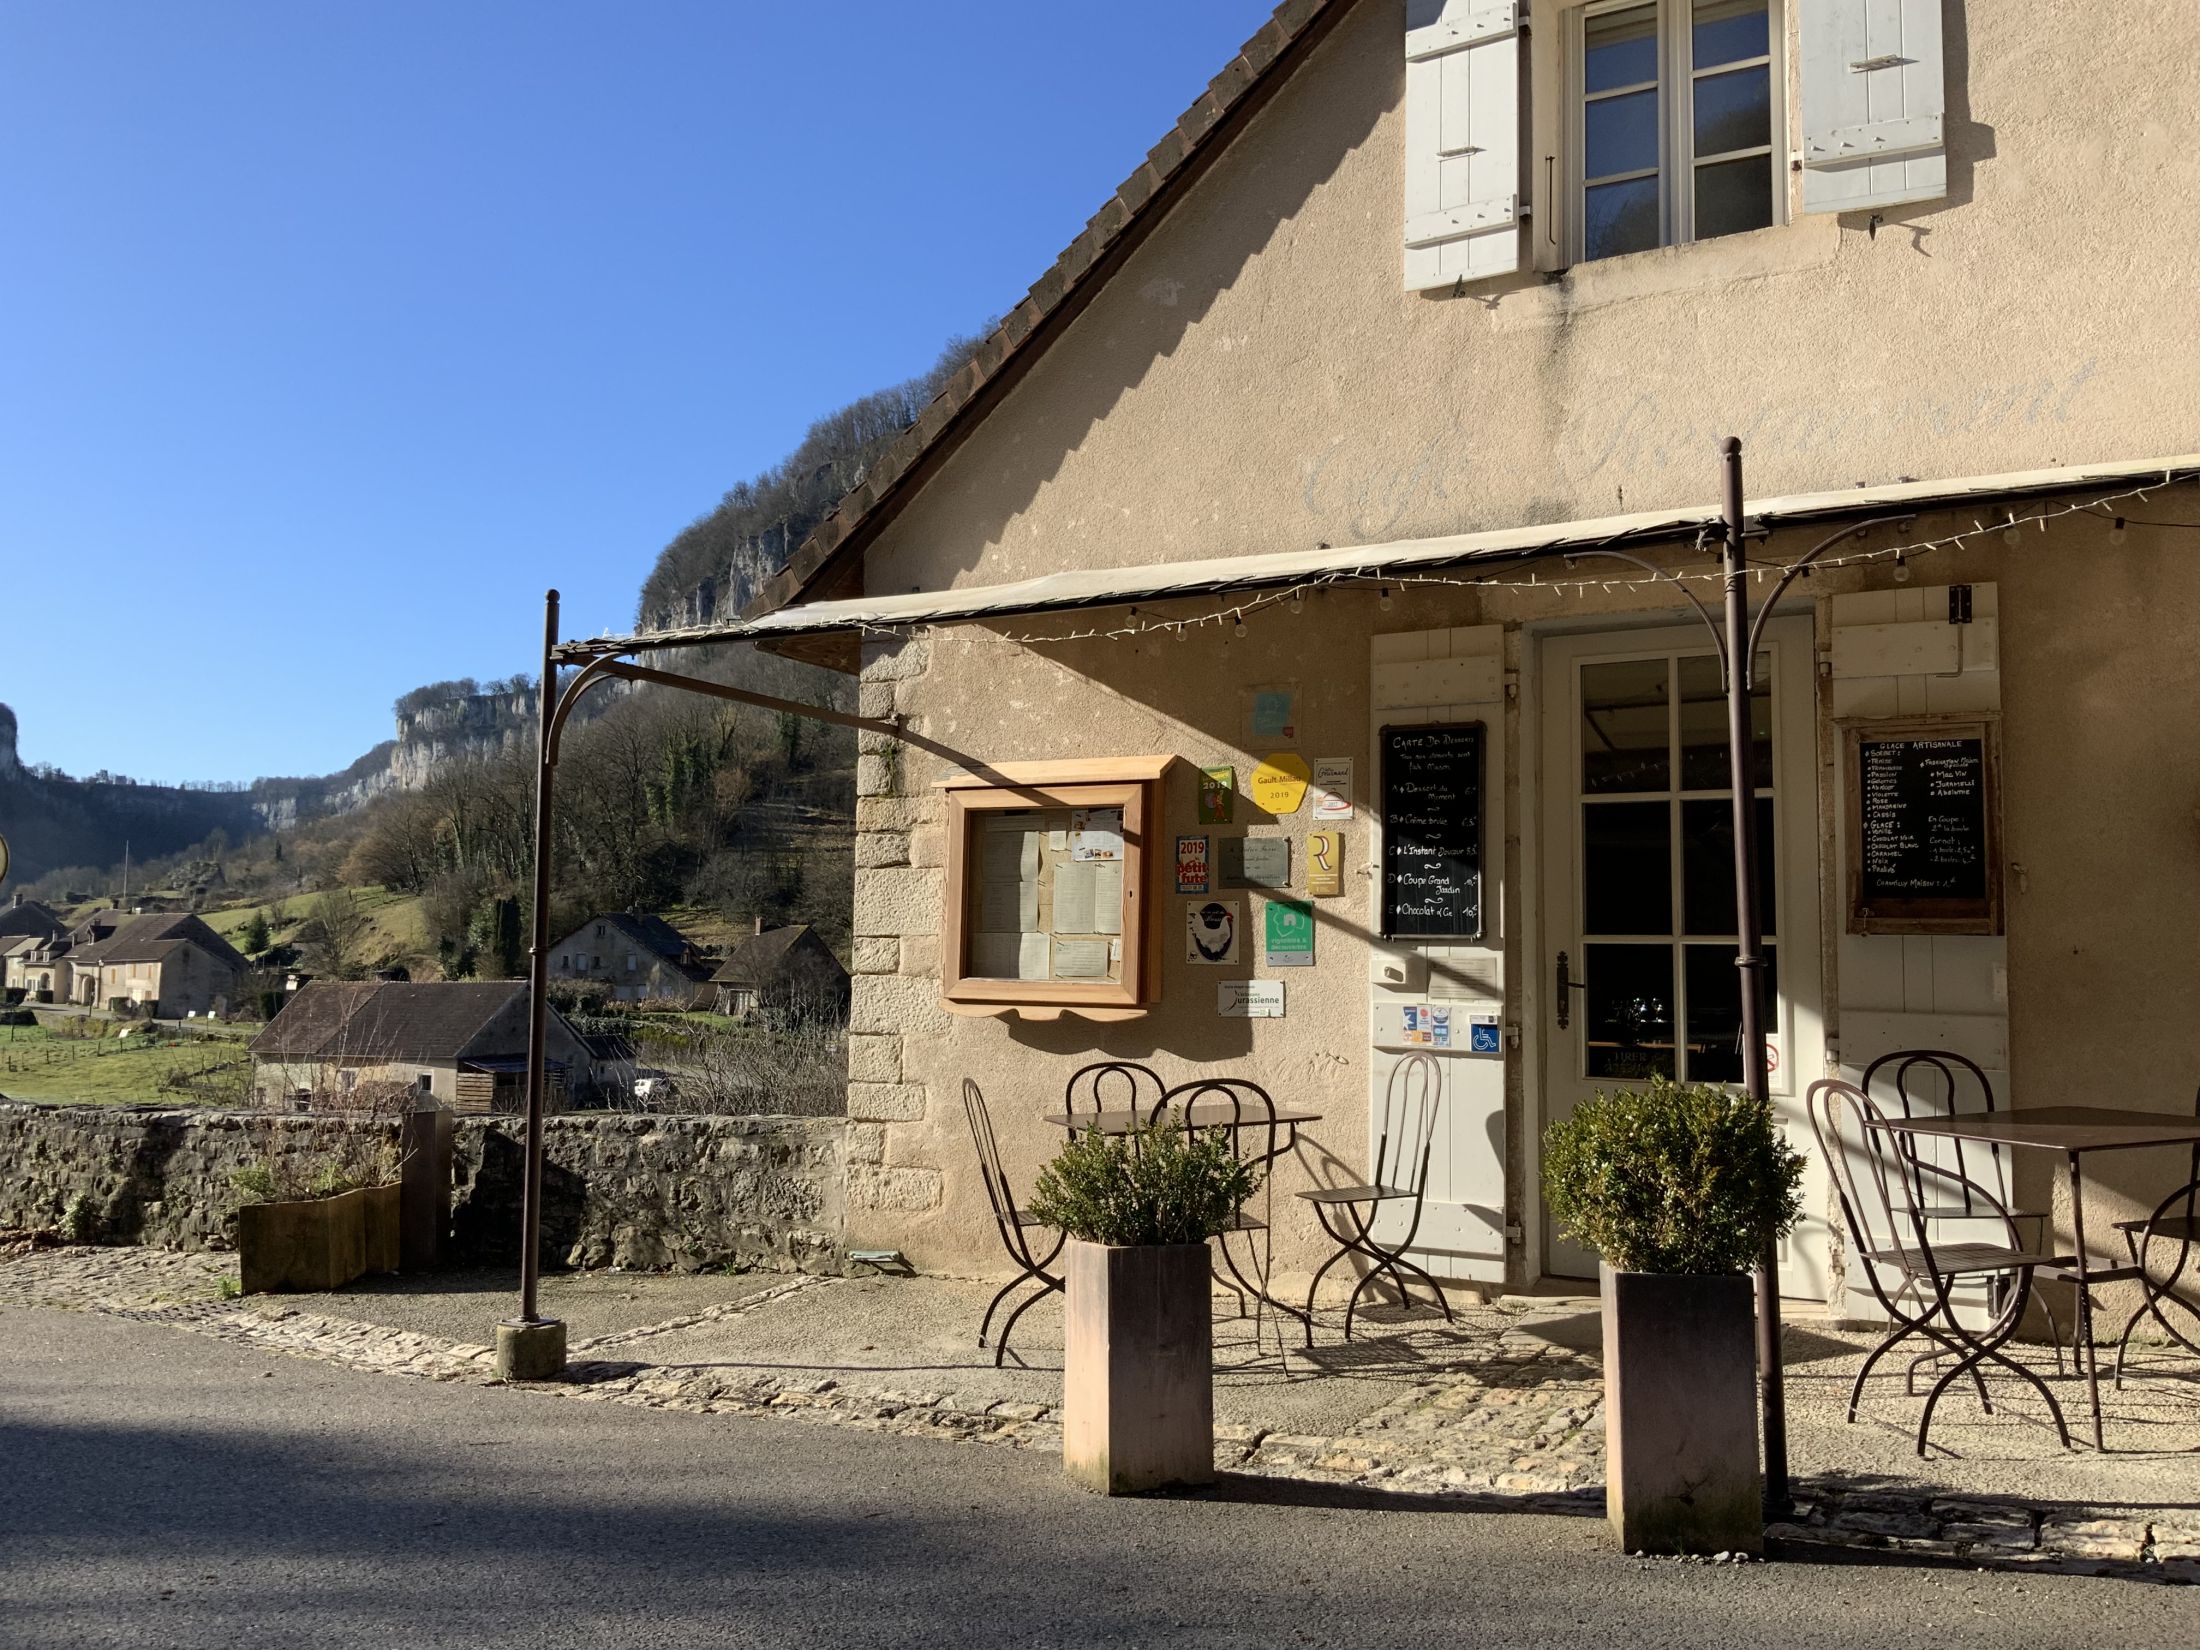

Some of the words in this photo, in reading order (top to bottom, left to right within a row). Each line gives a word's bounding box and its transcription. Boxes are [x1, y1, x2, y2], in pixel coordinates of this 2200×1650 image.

[1393, 736, 1424, 751] CARTE
[1912, 741, 1963, 750] ARTISANALE
[1203, 781, 1228, 790] 2019
[1270, 791, 1289, 799] 2019
[1181, 841, 1205, 854] 2019
[1389, 845, 1396, 856] C
[1403, 843, 1437, 856] L'Instant
[1387, 873, 1396, 884] D
[1403, 873, 1427, 888] Coupe
[1427, 875, 1450, 885] Grand
[1435, 884, 1461, 895] Jardin
[1401, 902, 1435, 916] Chocolat
